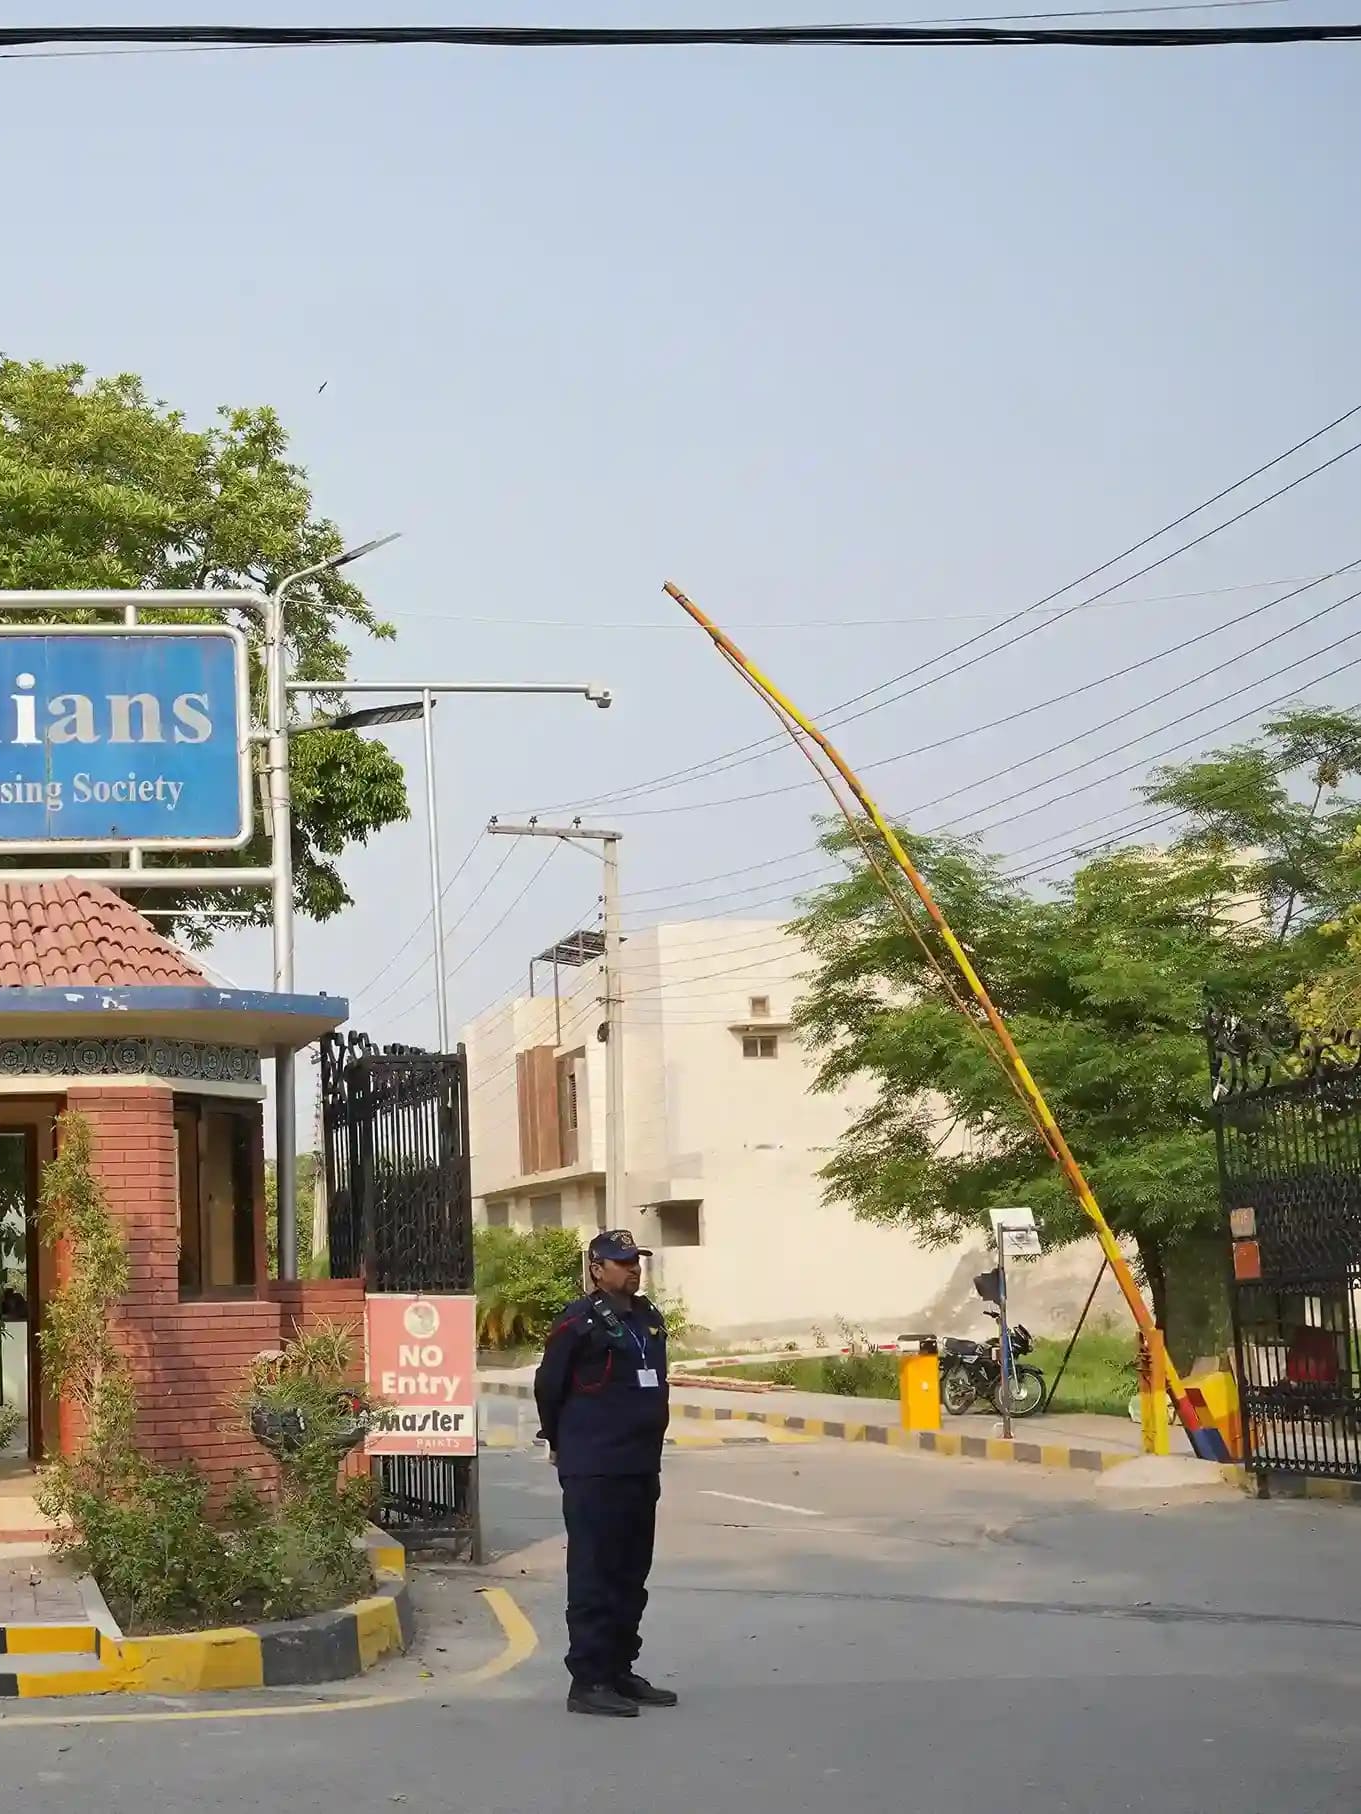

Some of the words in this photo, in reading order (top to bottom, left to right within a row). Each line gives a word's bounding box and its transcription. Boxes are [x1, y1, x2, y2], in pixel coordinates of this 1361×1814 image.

[73, 772, 184, 811] Society
[399, 1345, 443, 1367] NO
[381, 1371, 461, 1402] Entry
[416, 1438, 460, 1448] PAINTS
